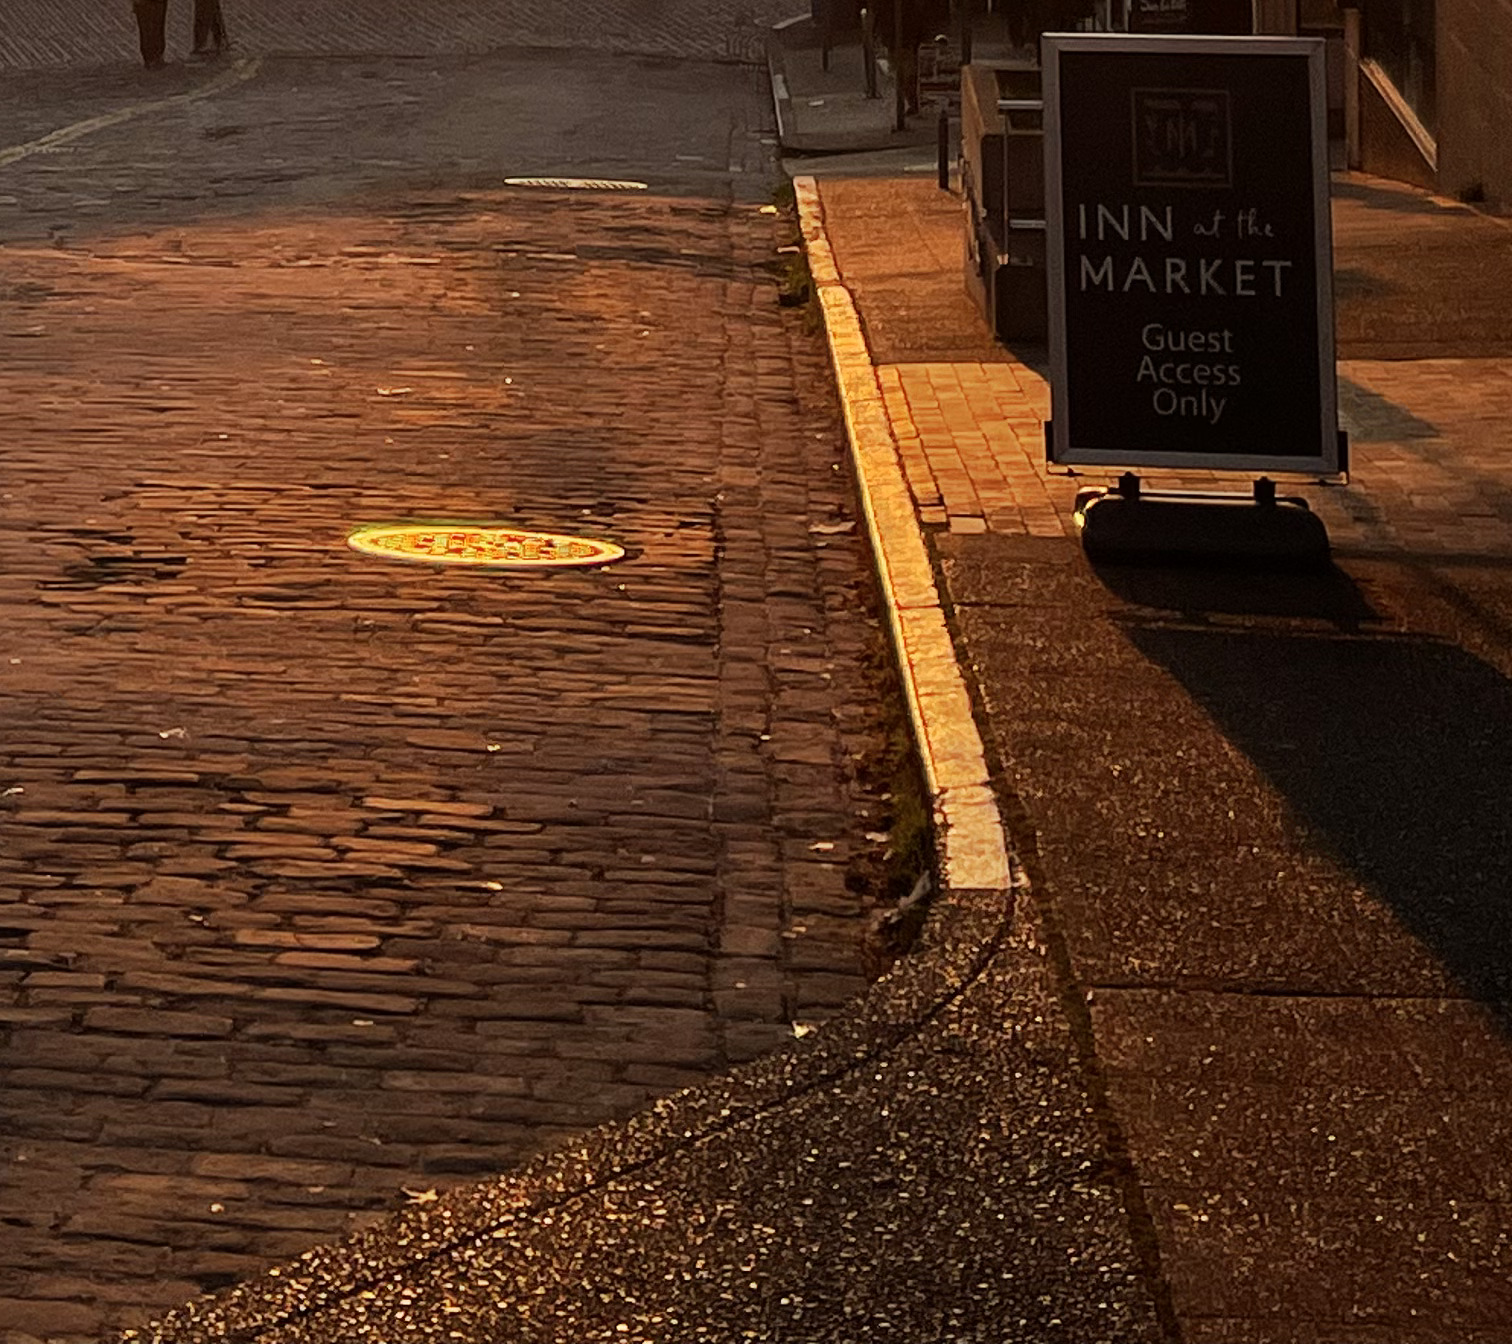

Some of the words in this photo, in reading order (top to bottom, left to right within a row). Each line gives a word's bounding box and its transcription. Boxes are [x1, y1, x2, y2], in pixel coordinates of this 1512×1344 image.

[1079, 203, 1173, 242] INN
[1193, 209, 1226, 238] at
[1238, 208, 1275, 239] the
[1080, 254, 1292, 296] MARKET
[1141, 323, 1234, 353] Guest
[1136, 355, 1241, 385] Access
[1153, 387, 1228, 425] Only
